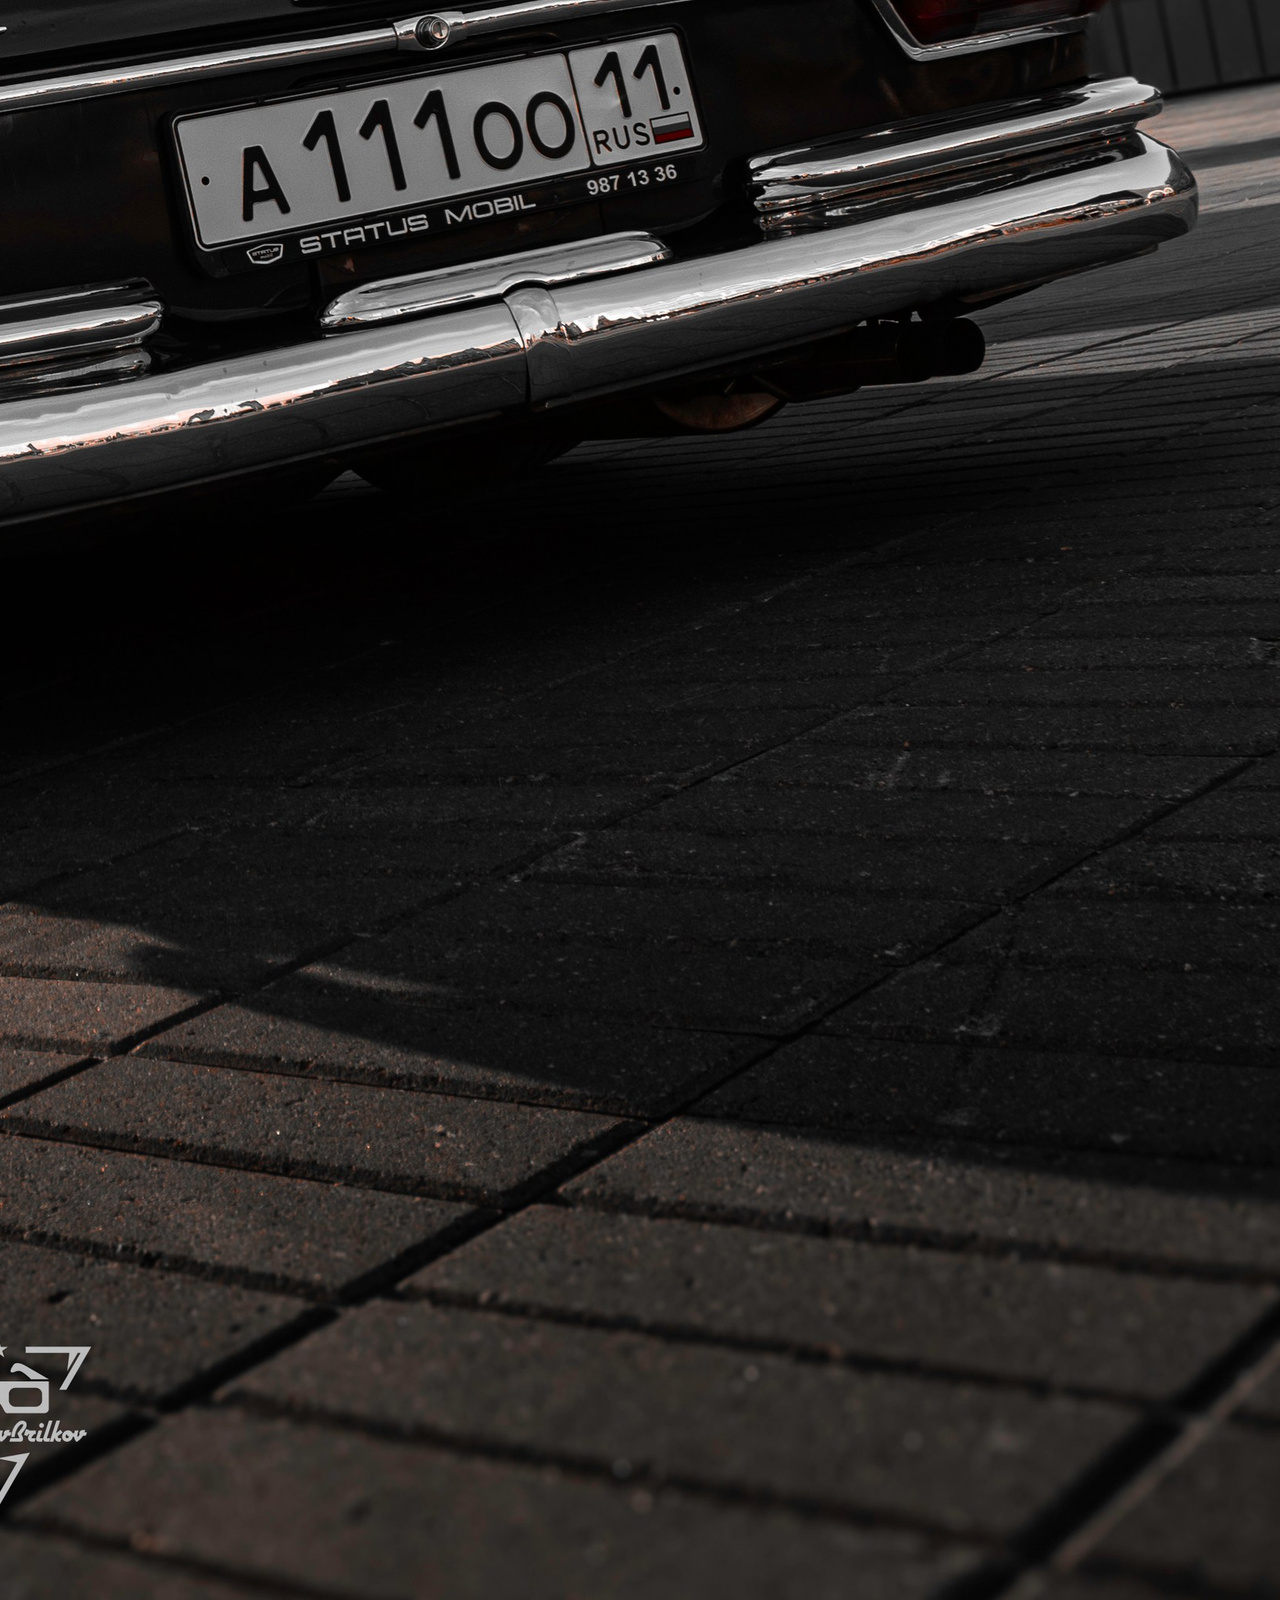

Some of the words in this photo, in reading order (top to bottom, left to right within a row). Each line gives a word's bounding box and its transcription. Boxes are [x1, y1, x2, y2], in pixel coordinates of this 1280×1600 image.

[592, 122, 651, 155] RUS
[586, 174, 620, 196] 987
[627, 169, 650, 188] 13
[654, 163, 678, 182] 36
[299, 213, 430, 255] STATUS
[445, 194, 537, 226] MOBIL
